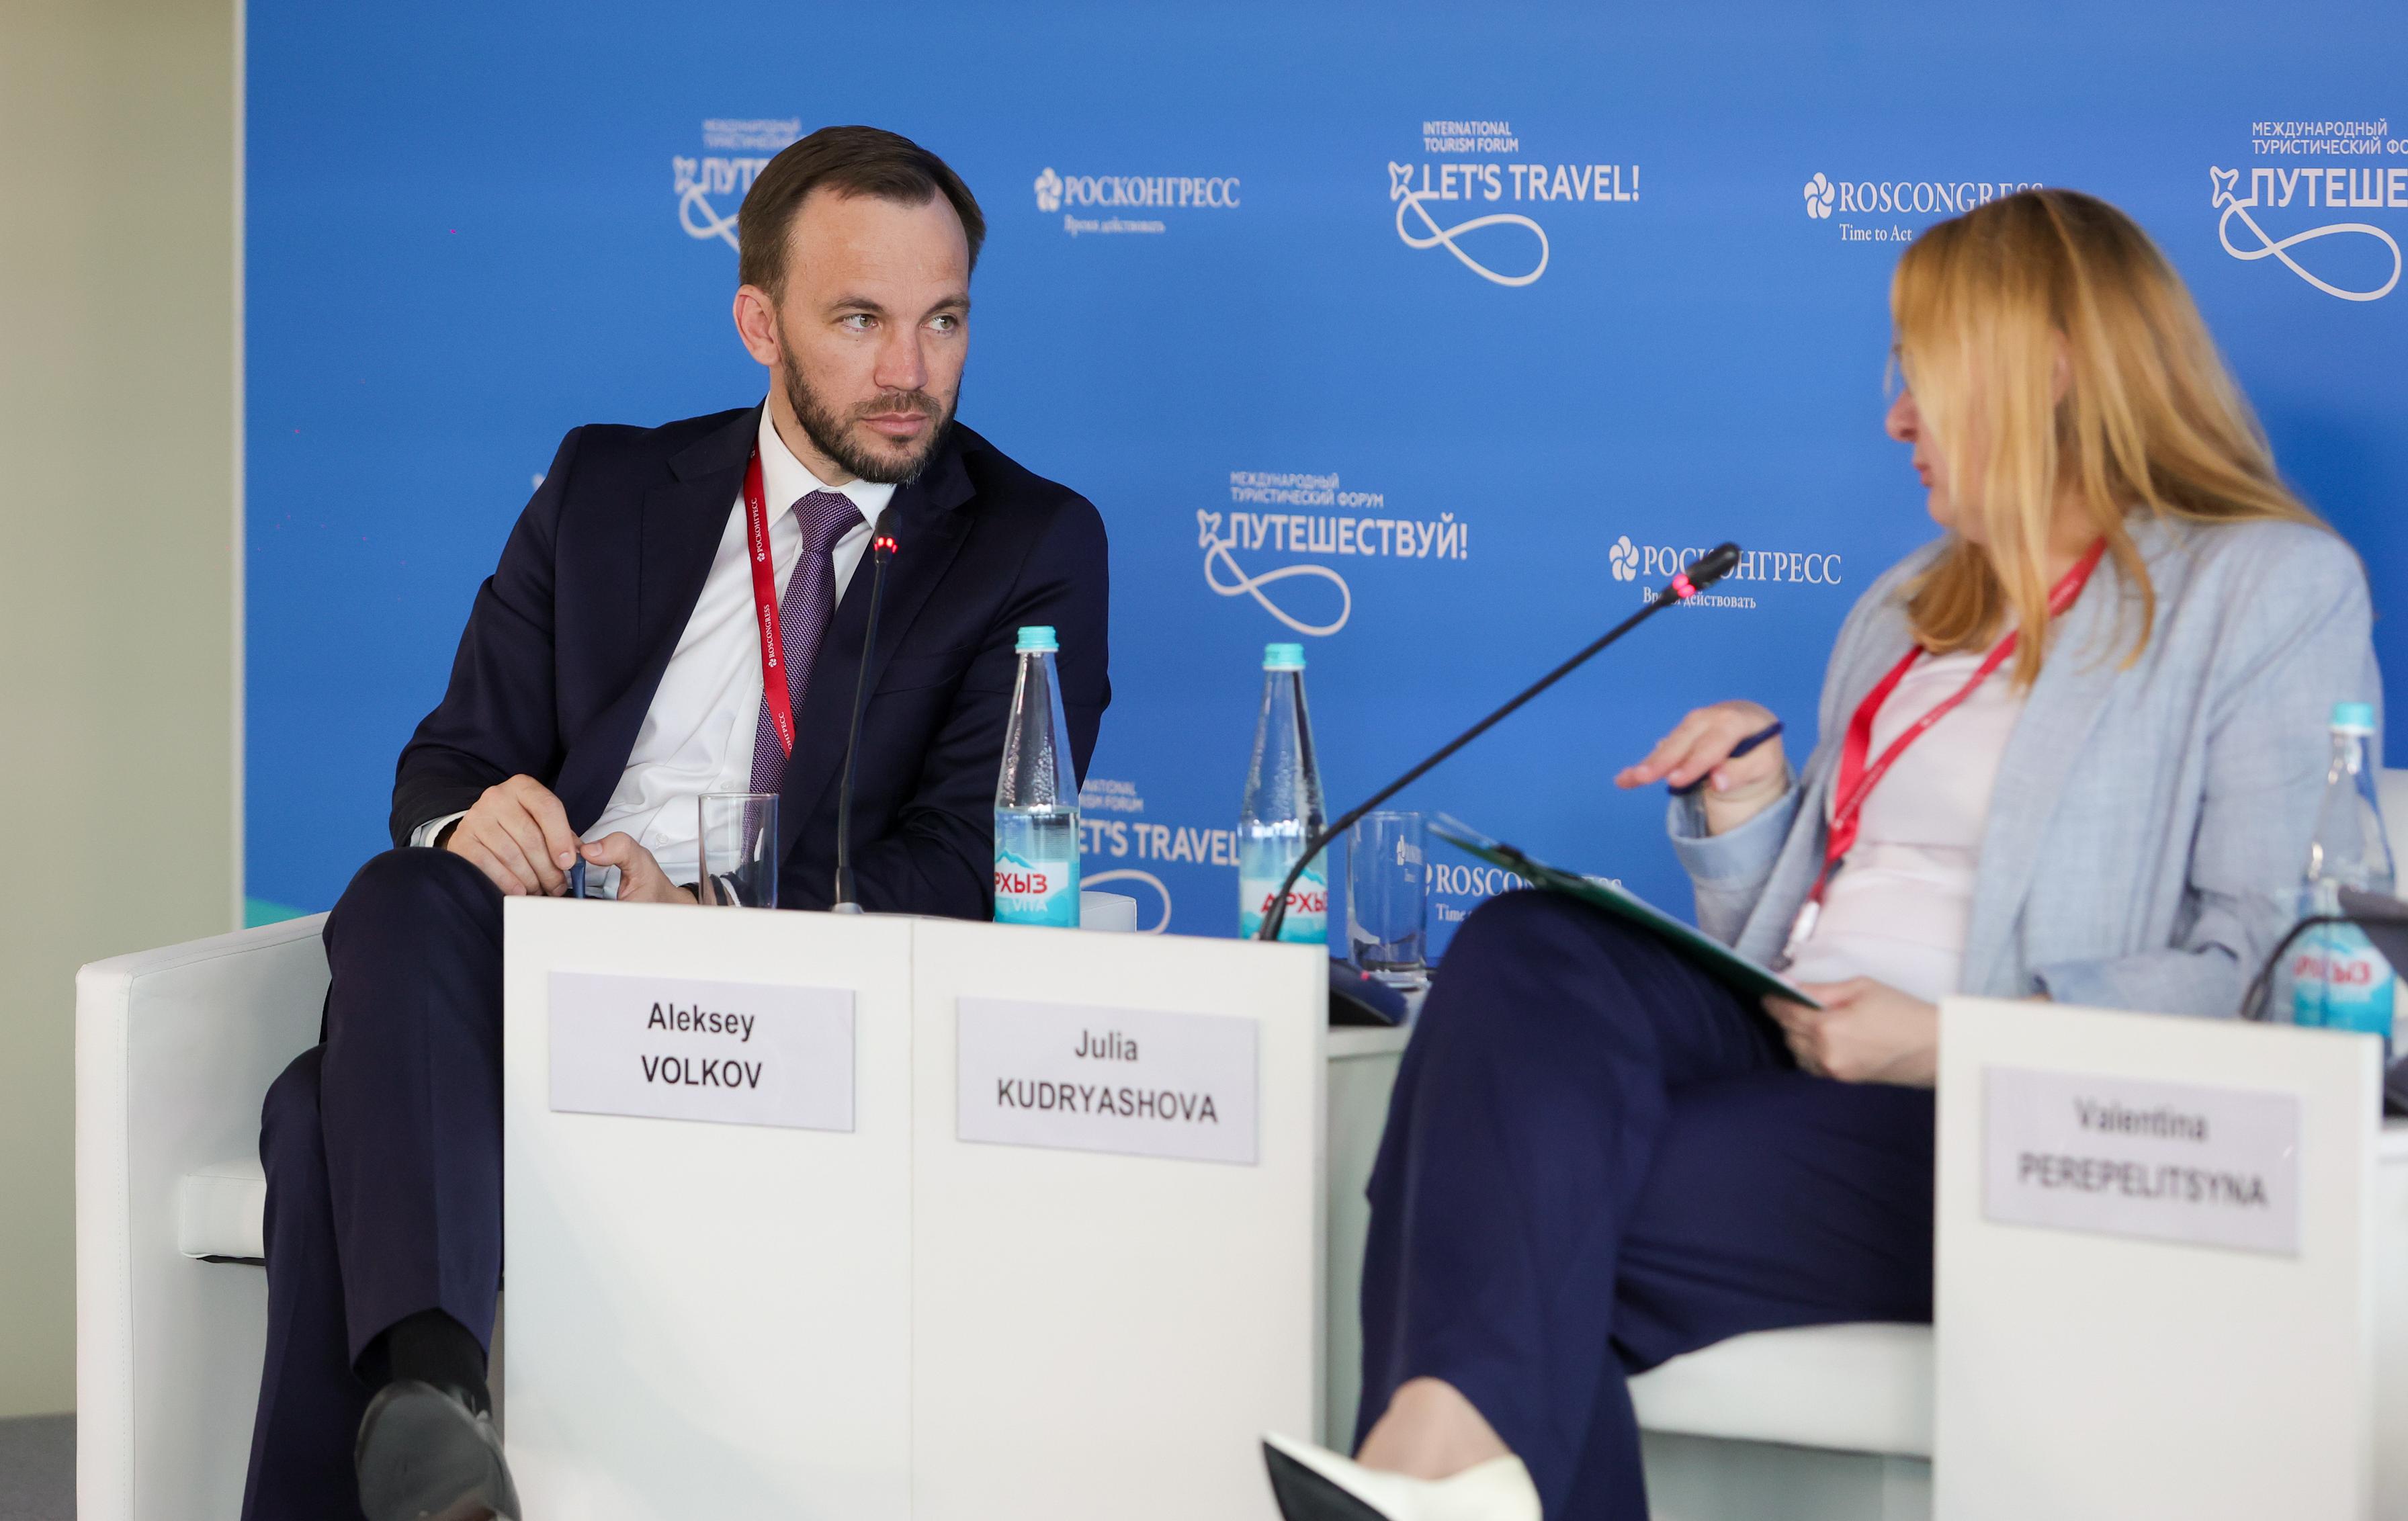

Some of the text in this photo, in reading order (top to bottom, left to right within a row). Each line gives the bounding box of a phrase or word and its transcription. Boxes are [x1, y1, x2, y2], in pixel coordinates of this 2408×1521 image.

[1423, 121, 1512, 136] INTERNATIONAL
[1424, 137, 1519, 153] TOURISM FORUM
[2251, 118, 2388, 138] МЕЖДУНАРОДНЫЙ
[2251, 136, 2382, 155] ТУРИСТИЧЕСКИЙ
[1064, 175, 1241, 208] РОСКОНГРЕСС
[1422, 163, 1640, 202] LET'S TRAVEL!
[1839, 223, 1913, 242] Time to Act
[1337, 491, 1384, 509] ФОРУМ
[751, 497, 763, 553] РОСКОНГРЕСС
[1230, 511, 1468, 560] ПУТЕШЕСТВУЙ!
[1643, 546, 1842, 584] РОСНГРЕСС
[1683, 591, 1757, 609] действовать
[763, 604, 775, 658] ROSCONGRESS
[778, 711, 793, 752] ОНГРЕСС
[647, 1002, 755, 1043] Aleksey
[1074, 1029, 1139, 1061] Julia
[641, 1055, 763, 1089] VOLKOV
[997, 1078, 1219, 1124] KUDRYASHOVA
[2075, 1095, 2209, 1142] Valentina
[2019, 1151, 2269, 1209] PEREPELITSYNA
